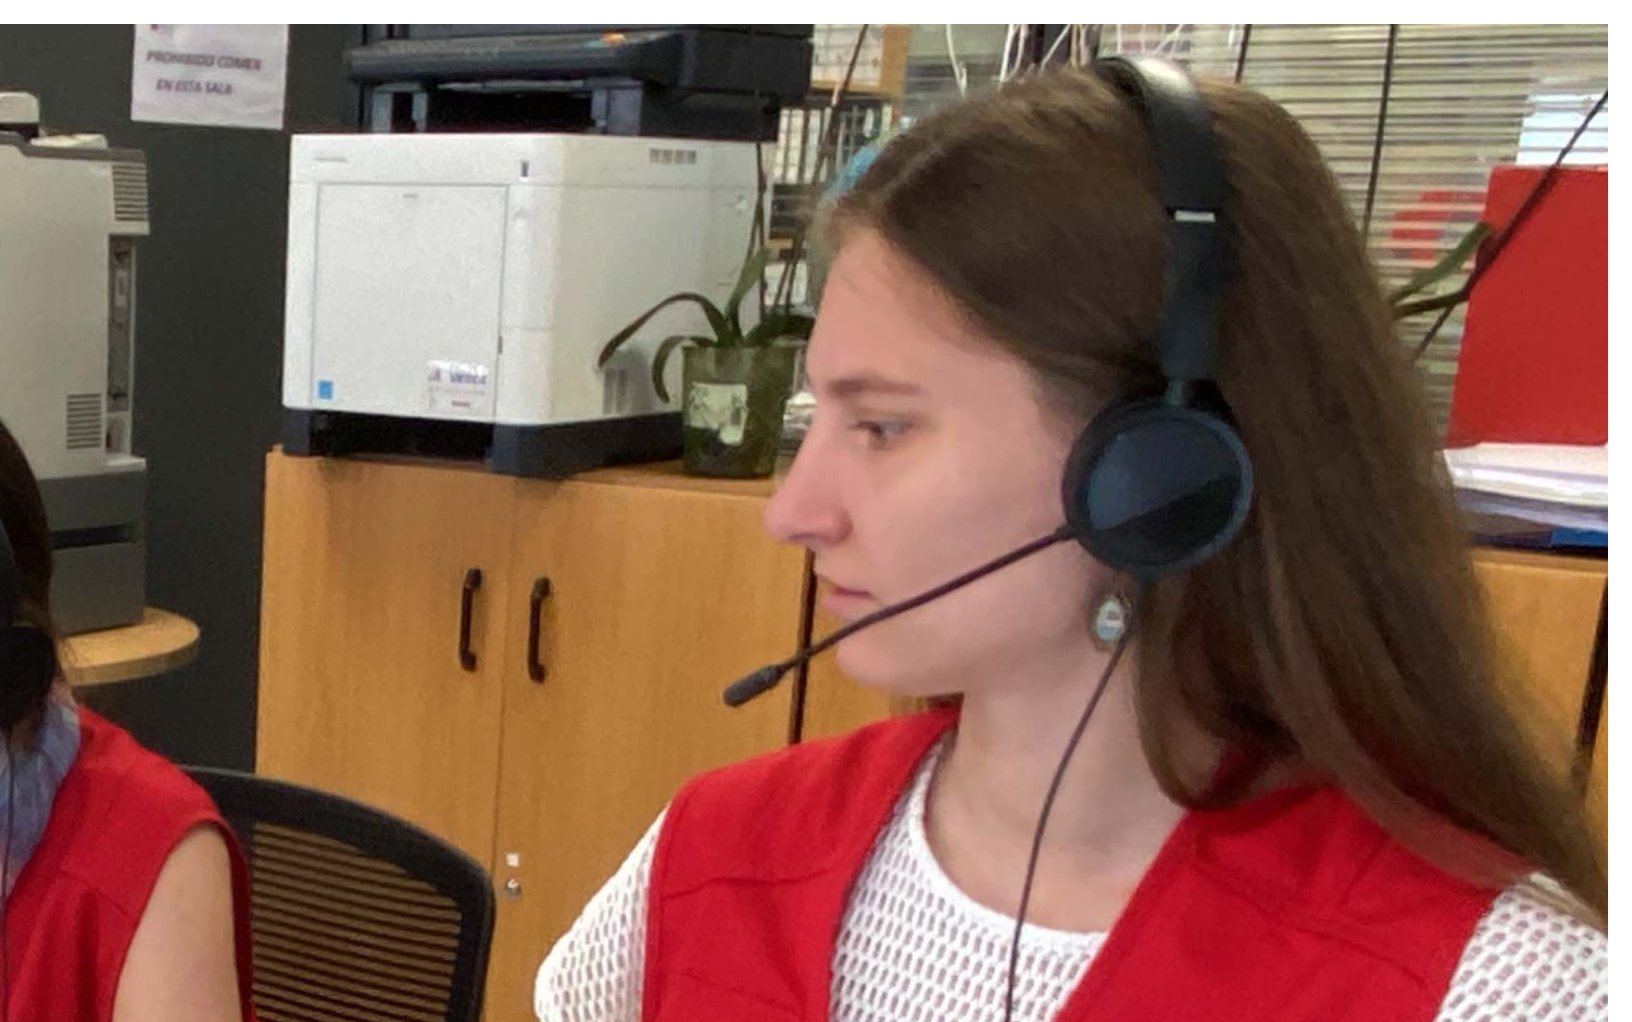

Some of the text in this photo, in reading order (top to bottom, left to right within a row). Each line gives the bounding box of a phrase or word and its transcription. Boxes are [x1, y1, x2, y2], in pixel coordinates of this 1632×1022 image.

[146, 51, 262, 71] PROHIBIDO COMER
[156, 79, 233, 95] EN ESTA SALA
